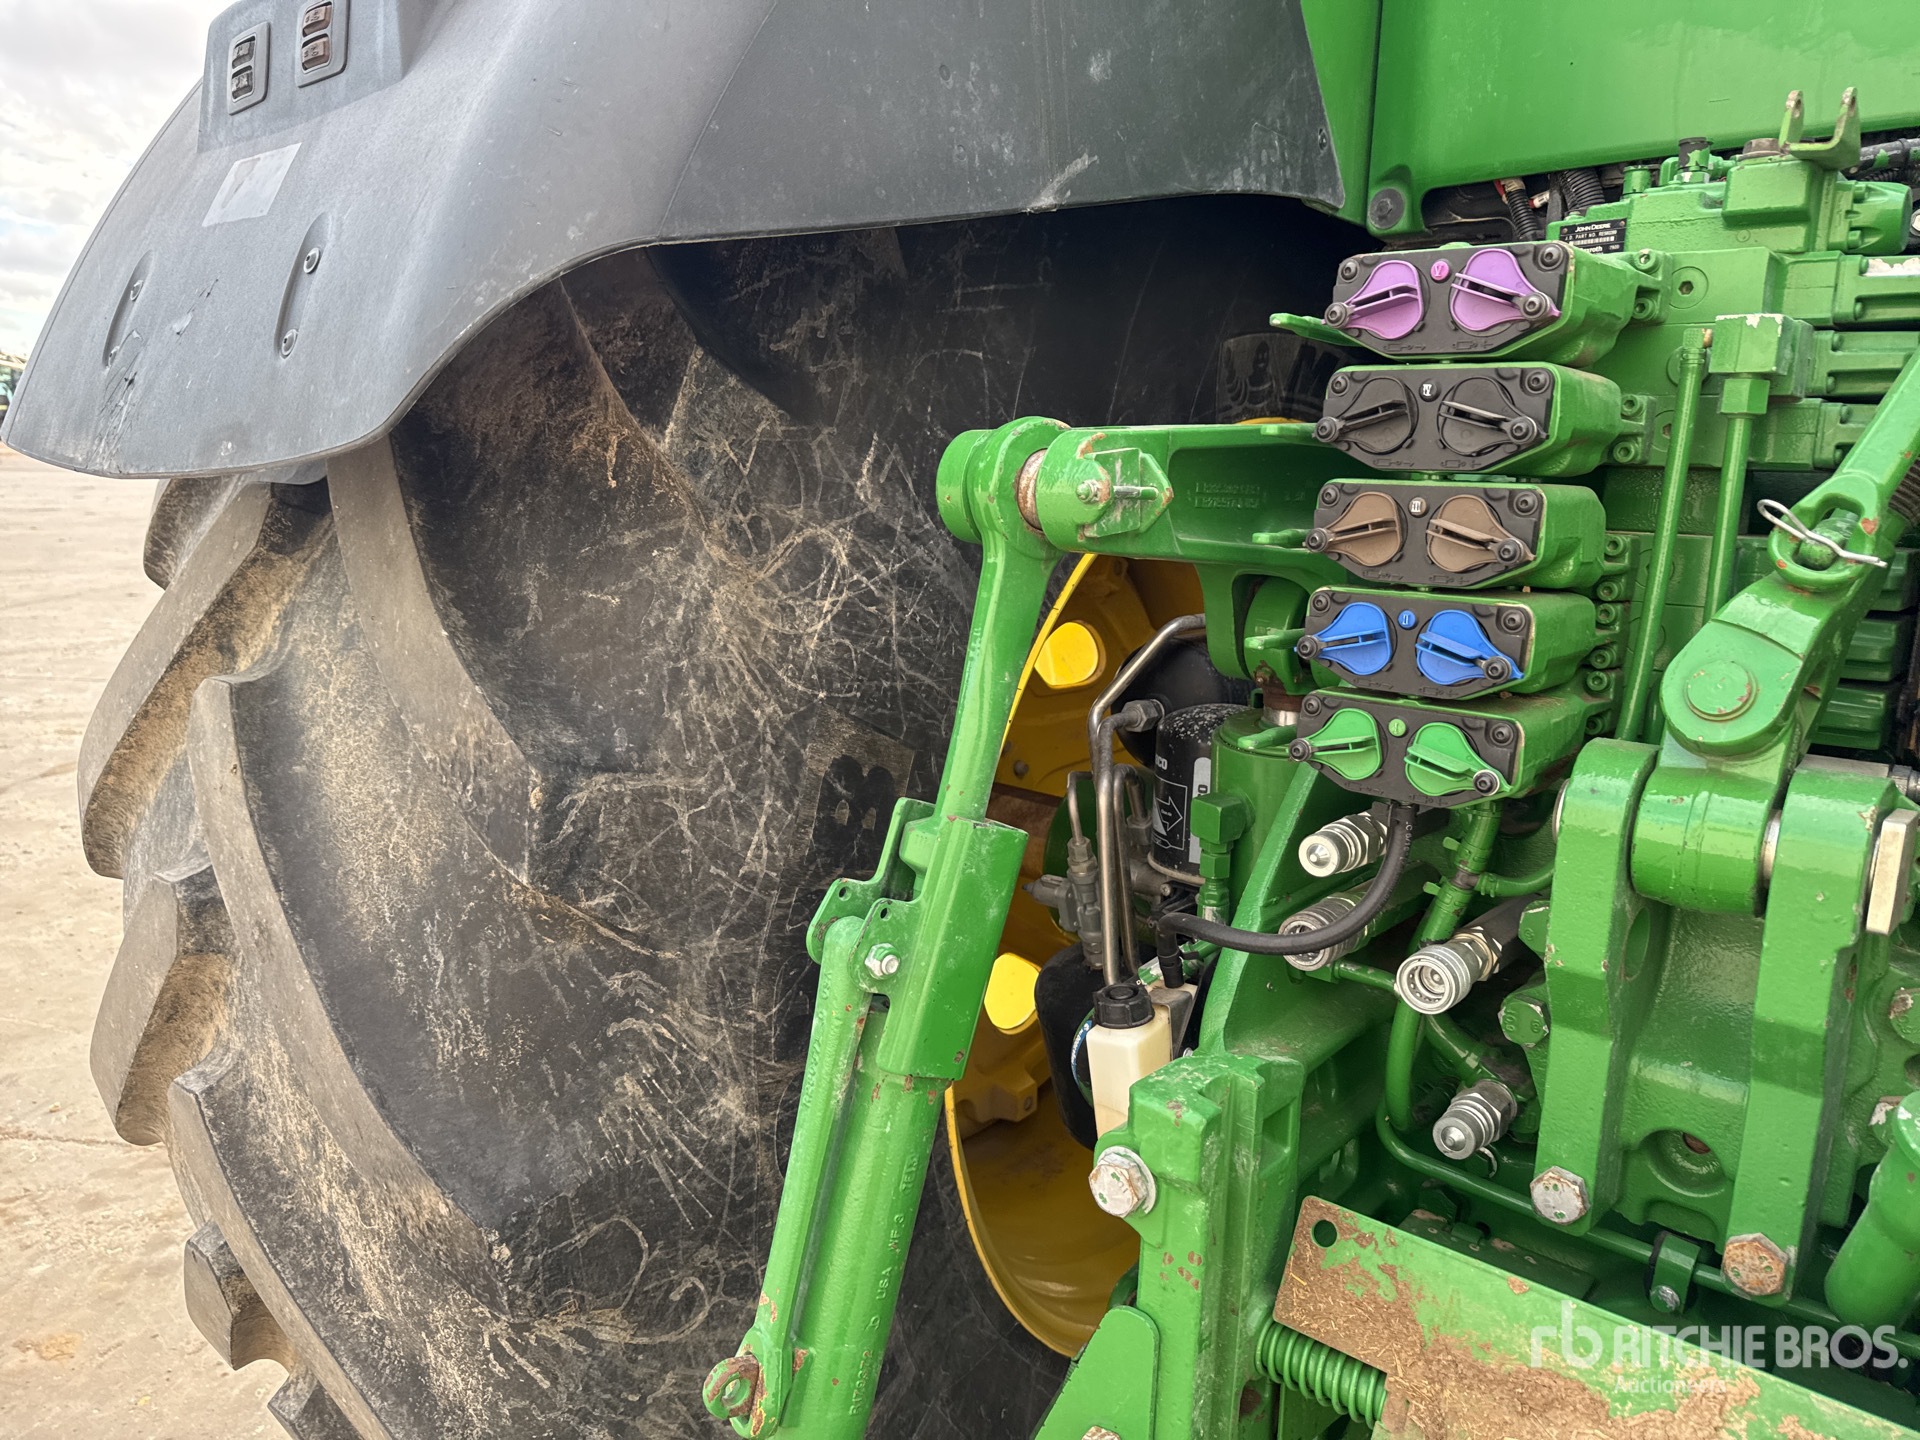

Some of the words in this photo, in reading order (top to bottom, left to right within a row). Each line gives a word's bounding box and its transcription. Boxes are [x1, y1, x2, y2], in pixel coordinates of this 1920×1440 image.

[1423, 384, 1432, 396] IV
[1411, 501, 1421, 512] III
[876, 1266, 892, 1300] USA
